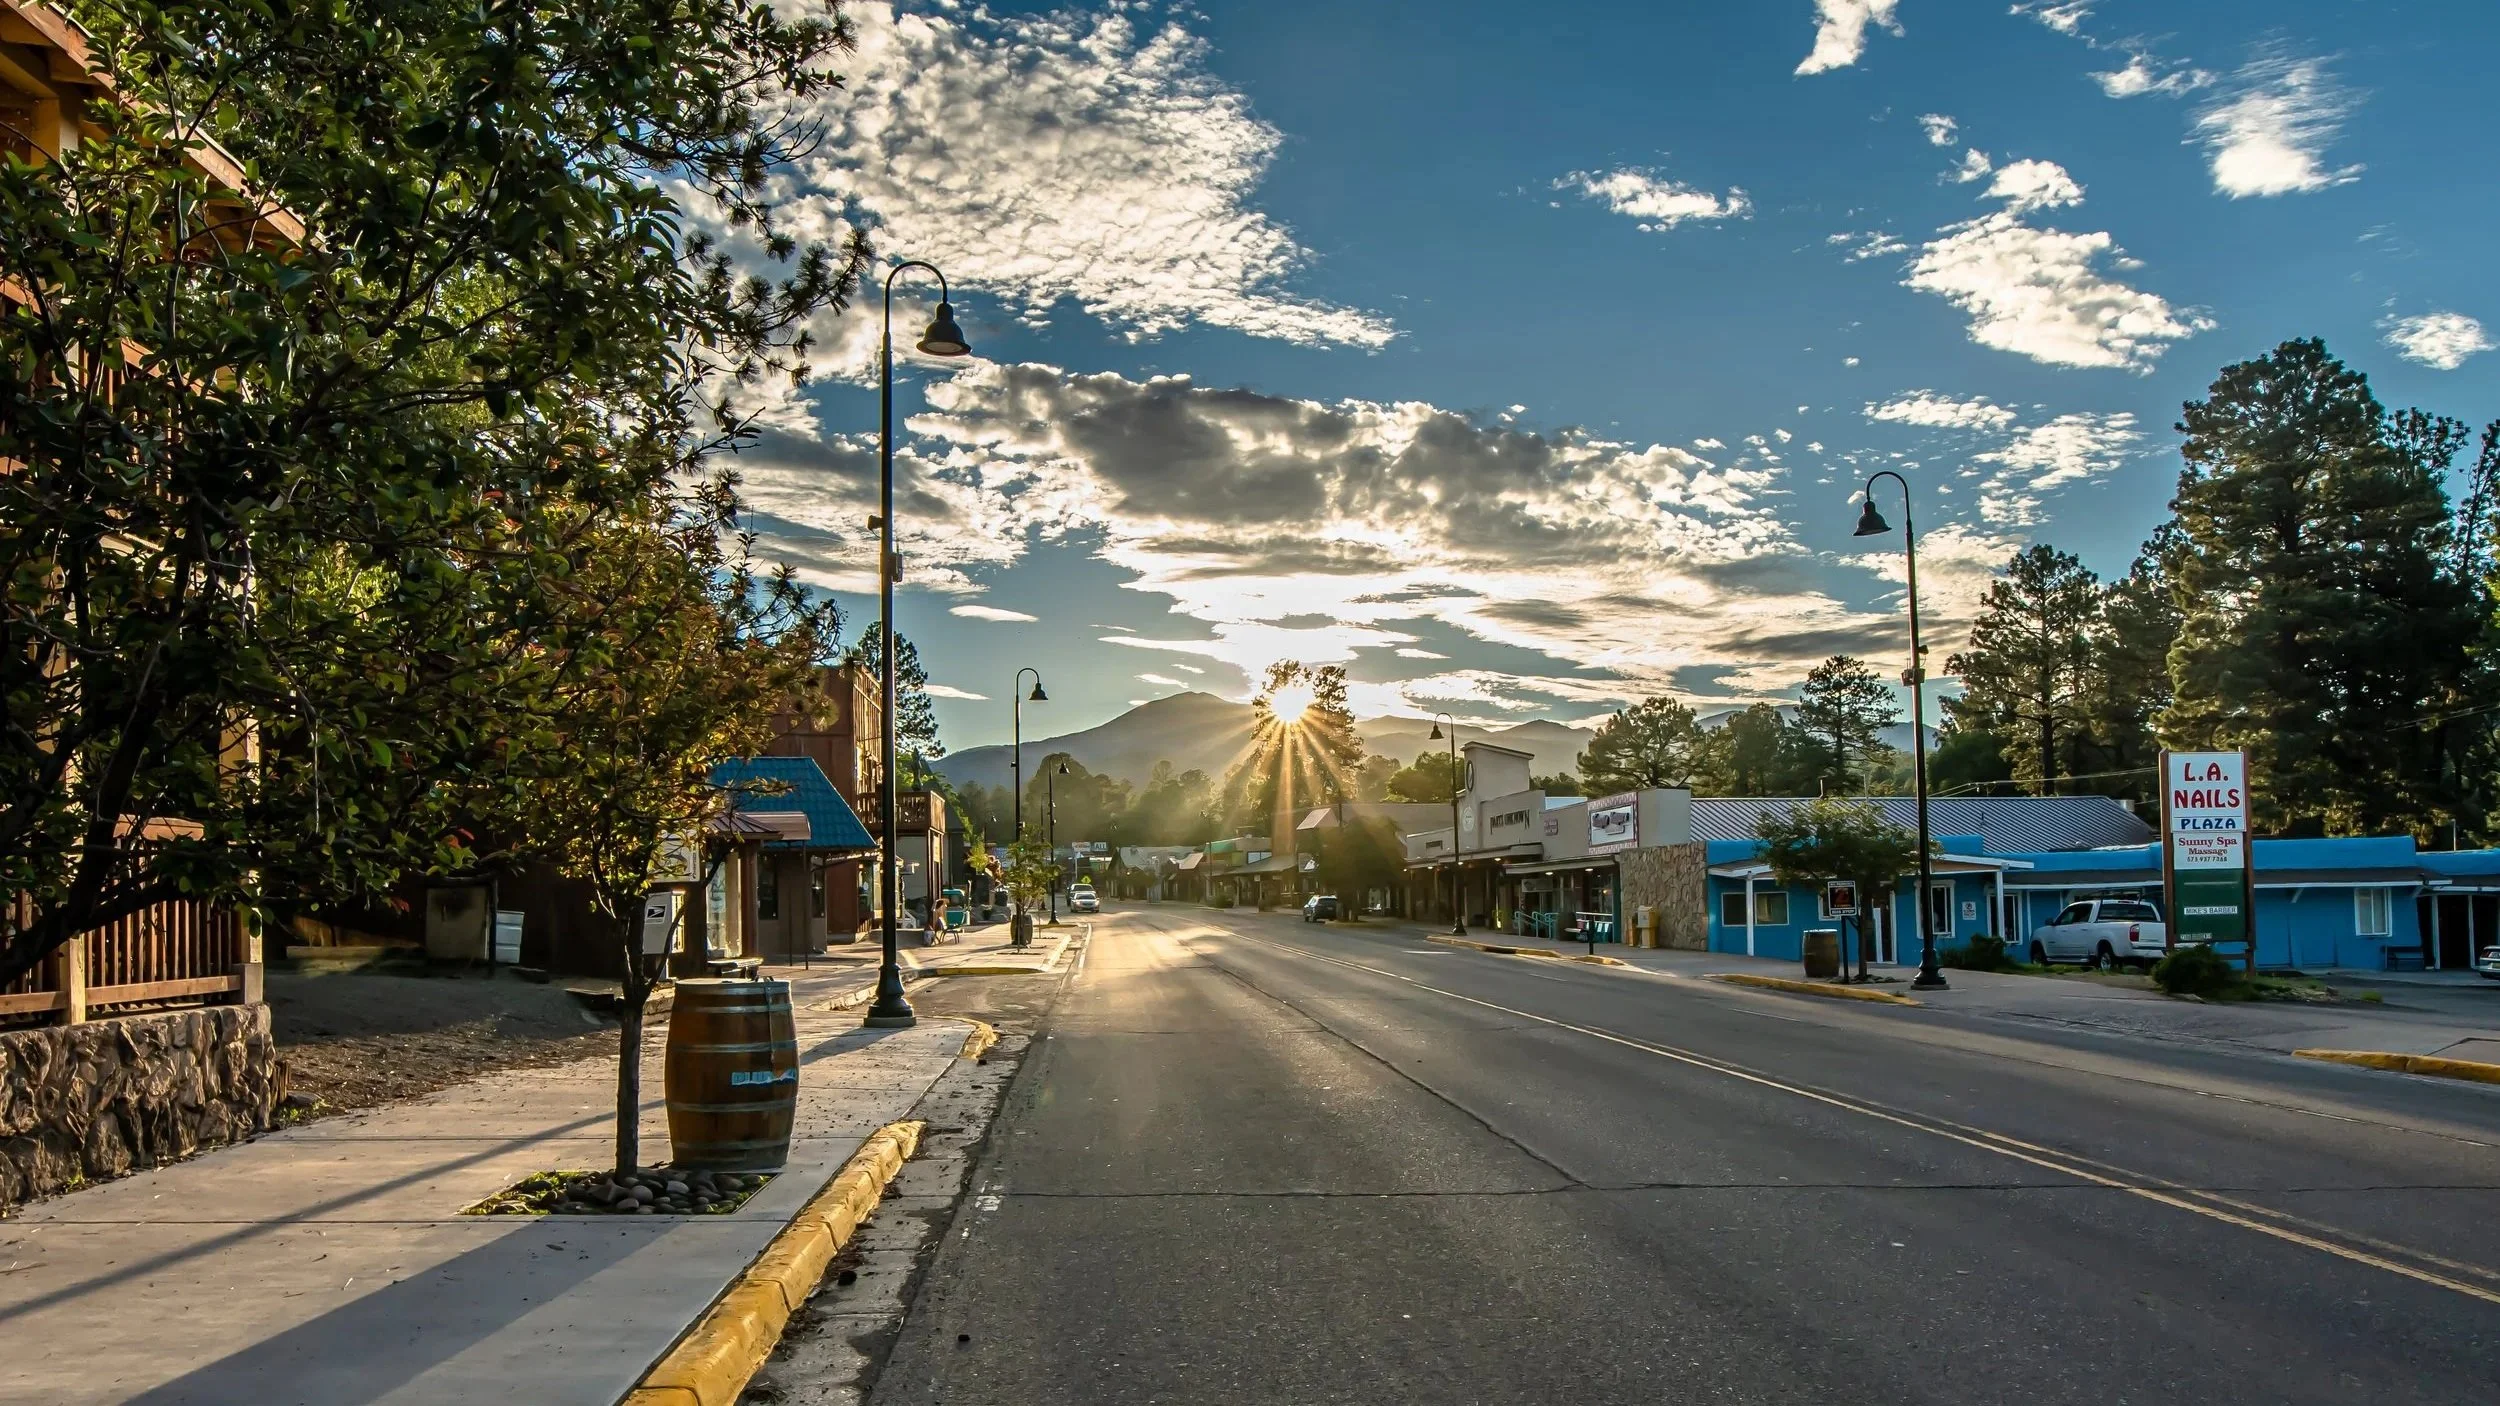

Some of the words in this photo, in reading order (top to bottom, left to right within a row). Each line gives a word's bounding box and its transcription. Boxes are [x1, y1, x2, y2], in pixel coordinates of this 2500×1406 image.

[2184, 762, 2229, 782] L.A.
[2174, 789, 2240, 809] NAILS
[2180, 818, 2236, 830] PLAZA
[2178, 837, 2213, 847] Sunny
[2216, 836, 2238, 847] Spa
[2188, 848, 2228, 856] Massage
[2185, 906, 2208, 914] MIKE'S
